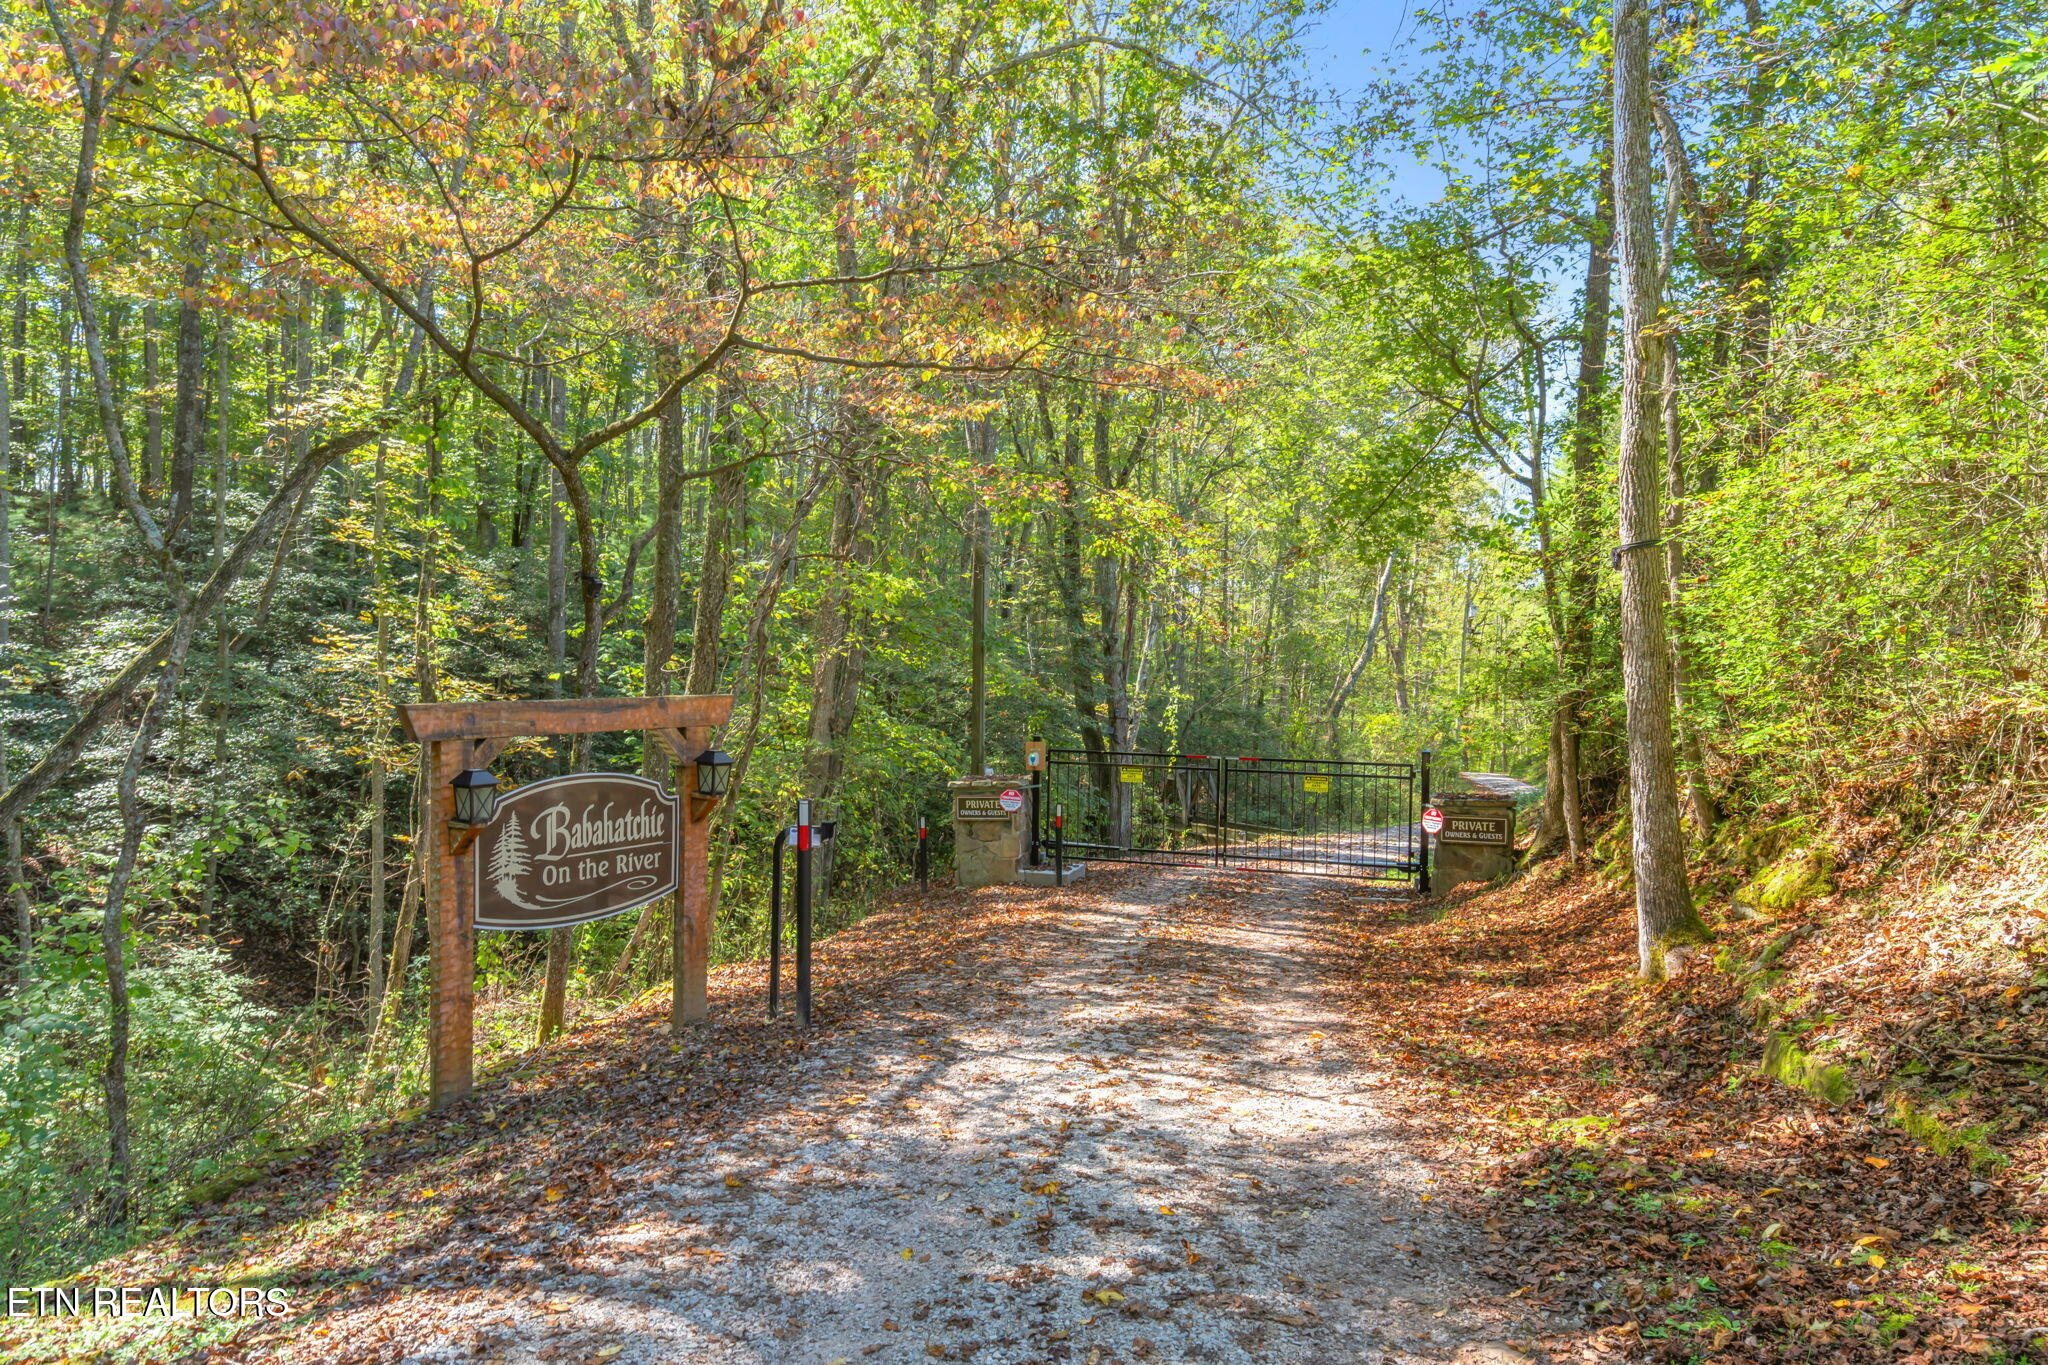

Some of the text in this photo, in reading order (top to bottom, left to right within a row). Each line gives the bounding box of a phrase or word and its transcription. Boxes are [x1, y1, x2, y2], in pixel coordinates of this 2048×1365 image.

[965, 800, 1000, 809] PRIVATE
[530, 798, 665, 862] Babahatchie
[1452, 820, 1496, 831] PRIVATE
[1479, 832, 1503, 840] GUESTS
[542, 851, 663, 887] On the River
